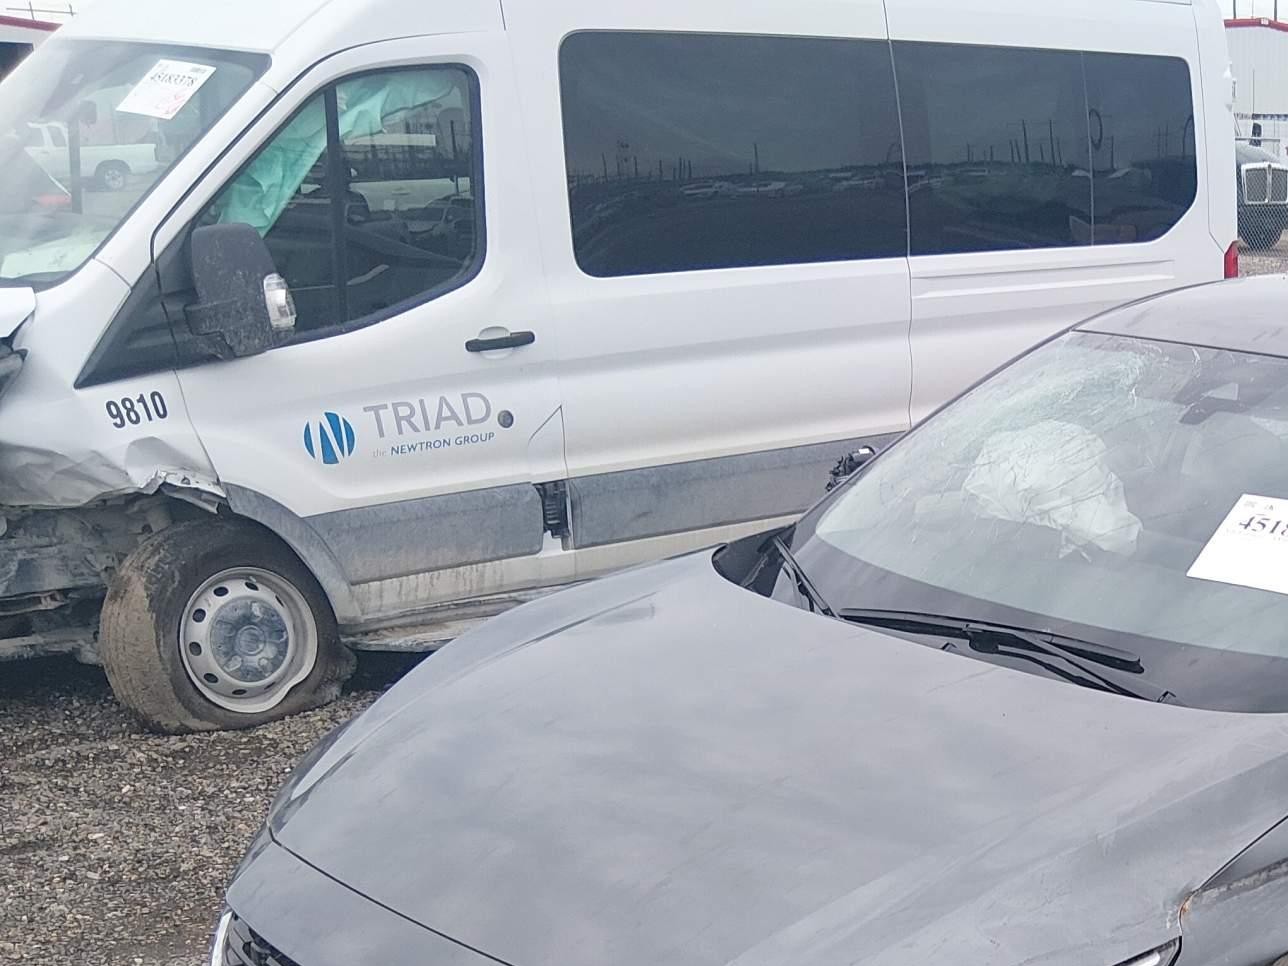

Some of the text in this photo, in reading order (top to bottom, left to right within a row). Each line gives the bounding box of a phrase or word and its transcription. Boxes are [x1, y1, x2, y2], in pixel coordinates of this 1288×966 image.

[105, 391, 168, 429] 9810
[363, 392, 492, 438] TRIAD
[372, 432, 495, 458] the NEWTRON GROUP
